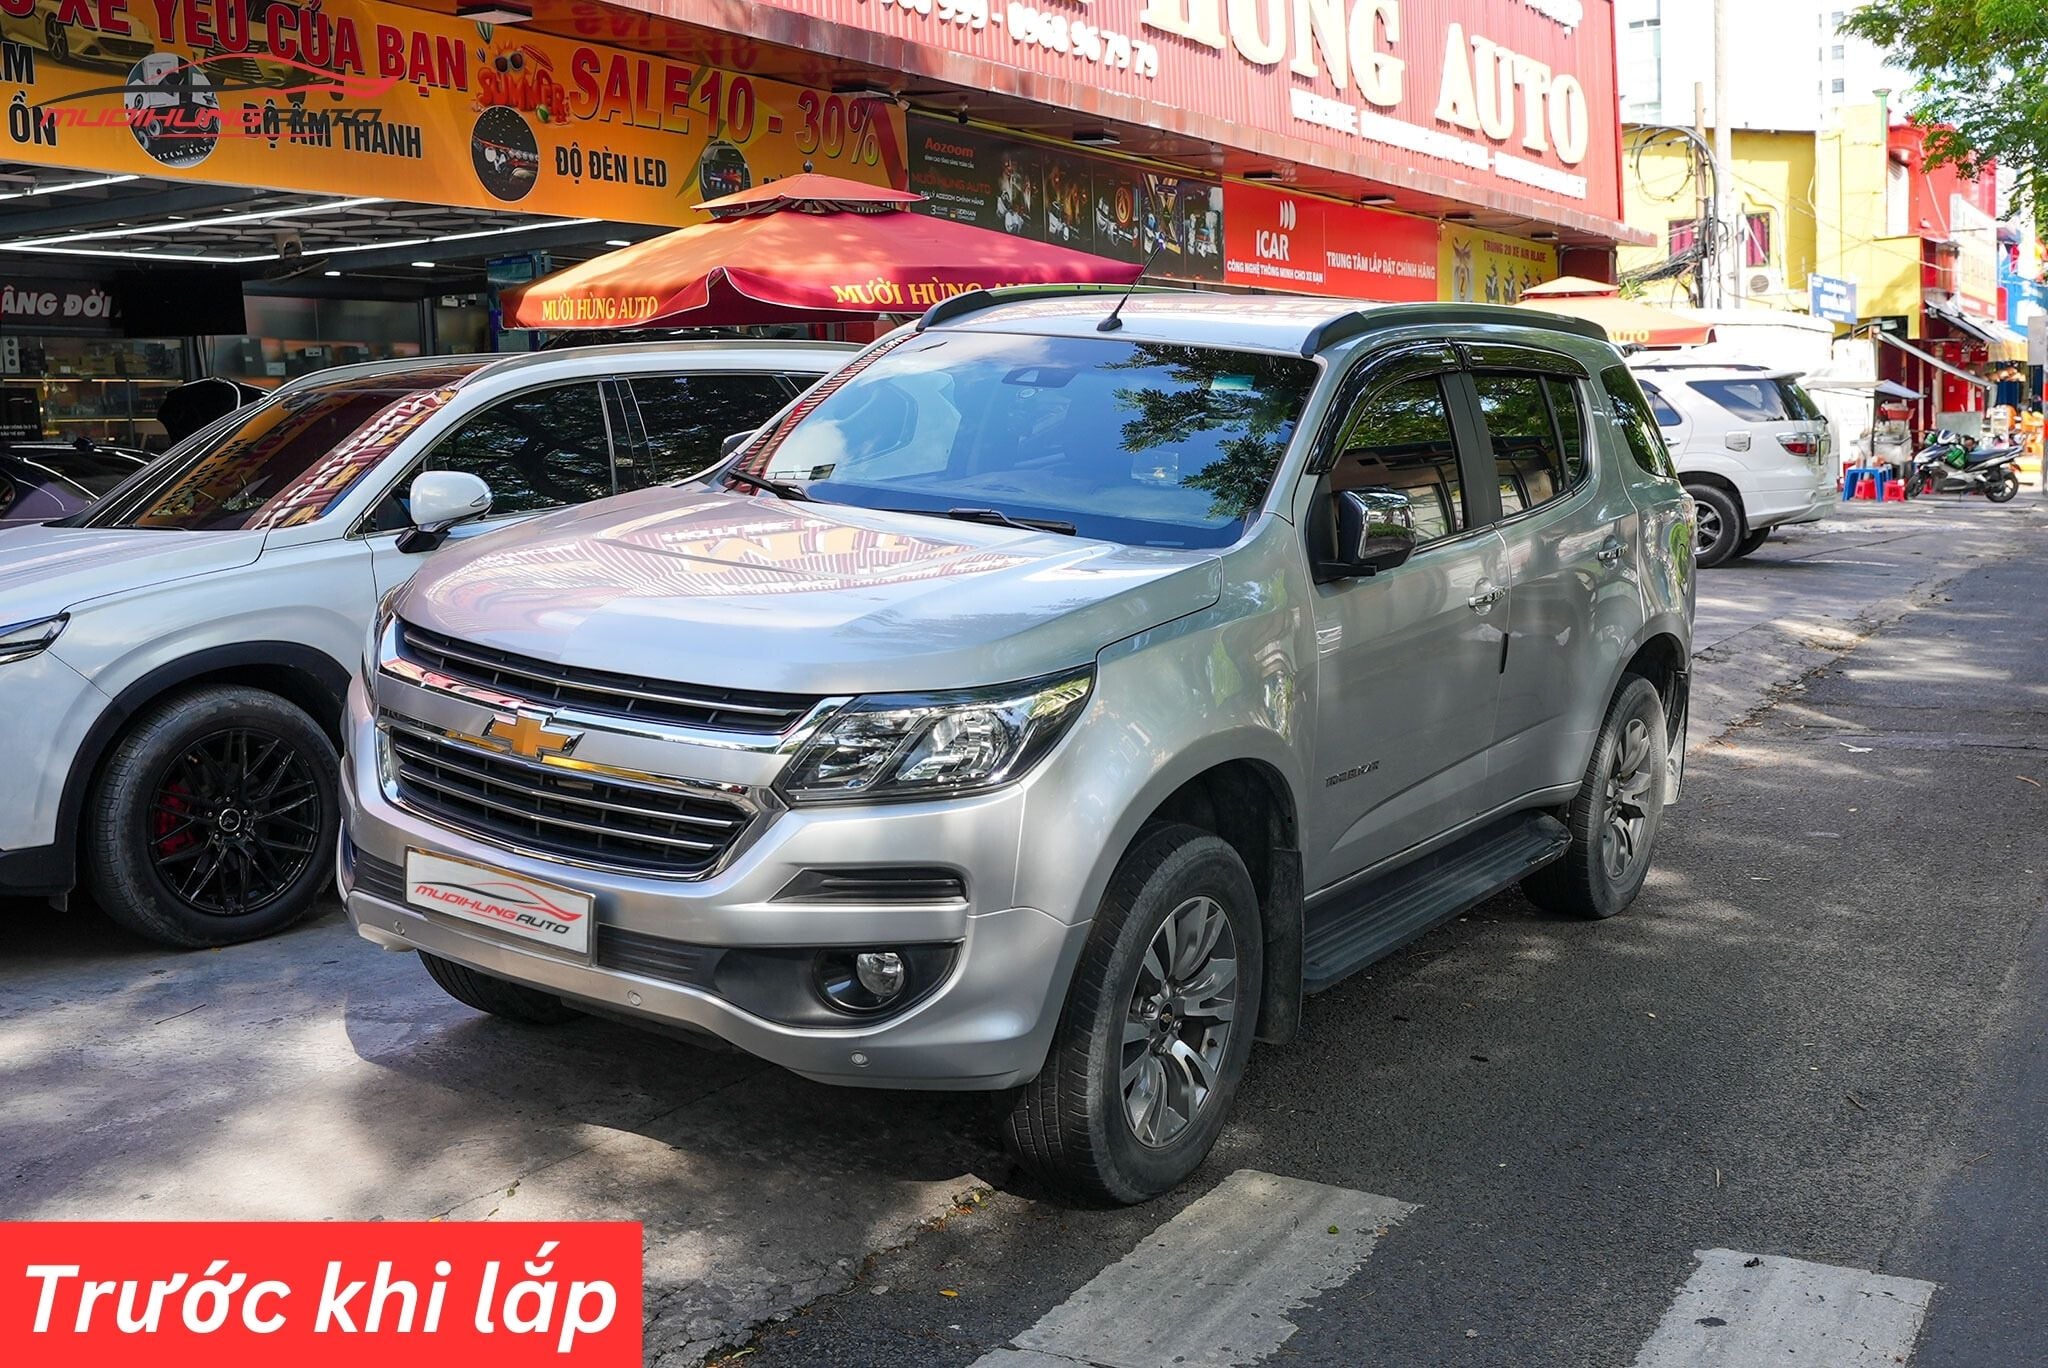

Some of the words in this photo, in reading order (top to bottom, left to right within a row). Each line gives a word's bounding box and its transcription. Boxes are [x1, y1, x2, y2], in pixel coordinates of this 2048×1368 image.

[0, 40, 36, 85] M
[265, 0, 366, 75] CỦA
[376, 23, 468, 97] BẠN
[569, 47, 692, 135] SALE
[700, 69, 756, 144] 10
[794, 89, 881, 167] 30%
[1434, 22, 1589, 165] AUTO
[243, 98, 281, 149] ĐỘ
[341, 113, 423, 159] THANH
[555, 142, 583, 185] ĐỘ
[588, 146, 628, 184] ĐÈN
[633, 156, 667, 188] LED
[1255, 229, 1290, 262] ICAR
[1326, 251, 1352, 270] TRUNG
[1352, 252, 1368, 272] TÂM
[1396, 259, 1417, 278] CHÍNH
[1226, 258, 1244, 273] CÔNG
[1294, 269, 1306, 281] CHO
[63, 288, 112, 319] ĐỜI
[541, 292, 575, 321] MƯỜI
[576, 291, 616, 320] HÙNG
[617, 296, 659, 320] AUTO
[831, 276, 904, 304] MƯỜI
